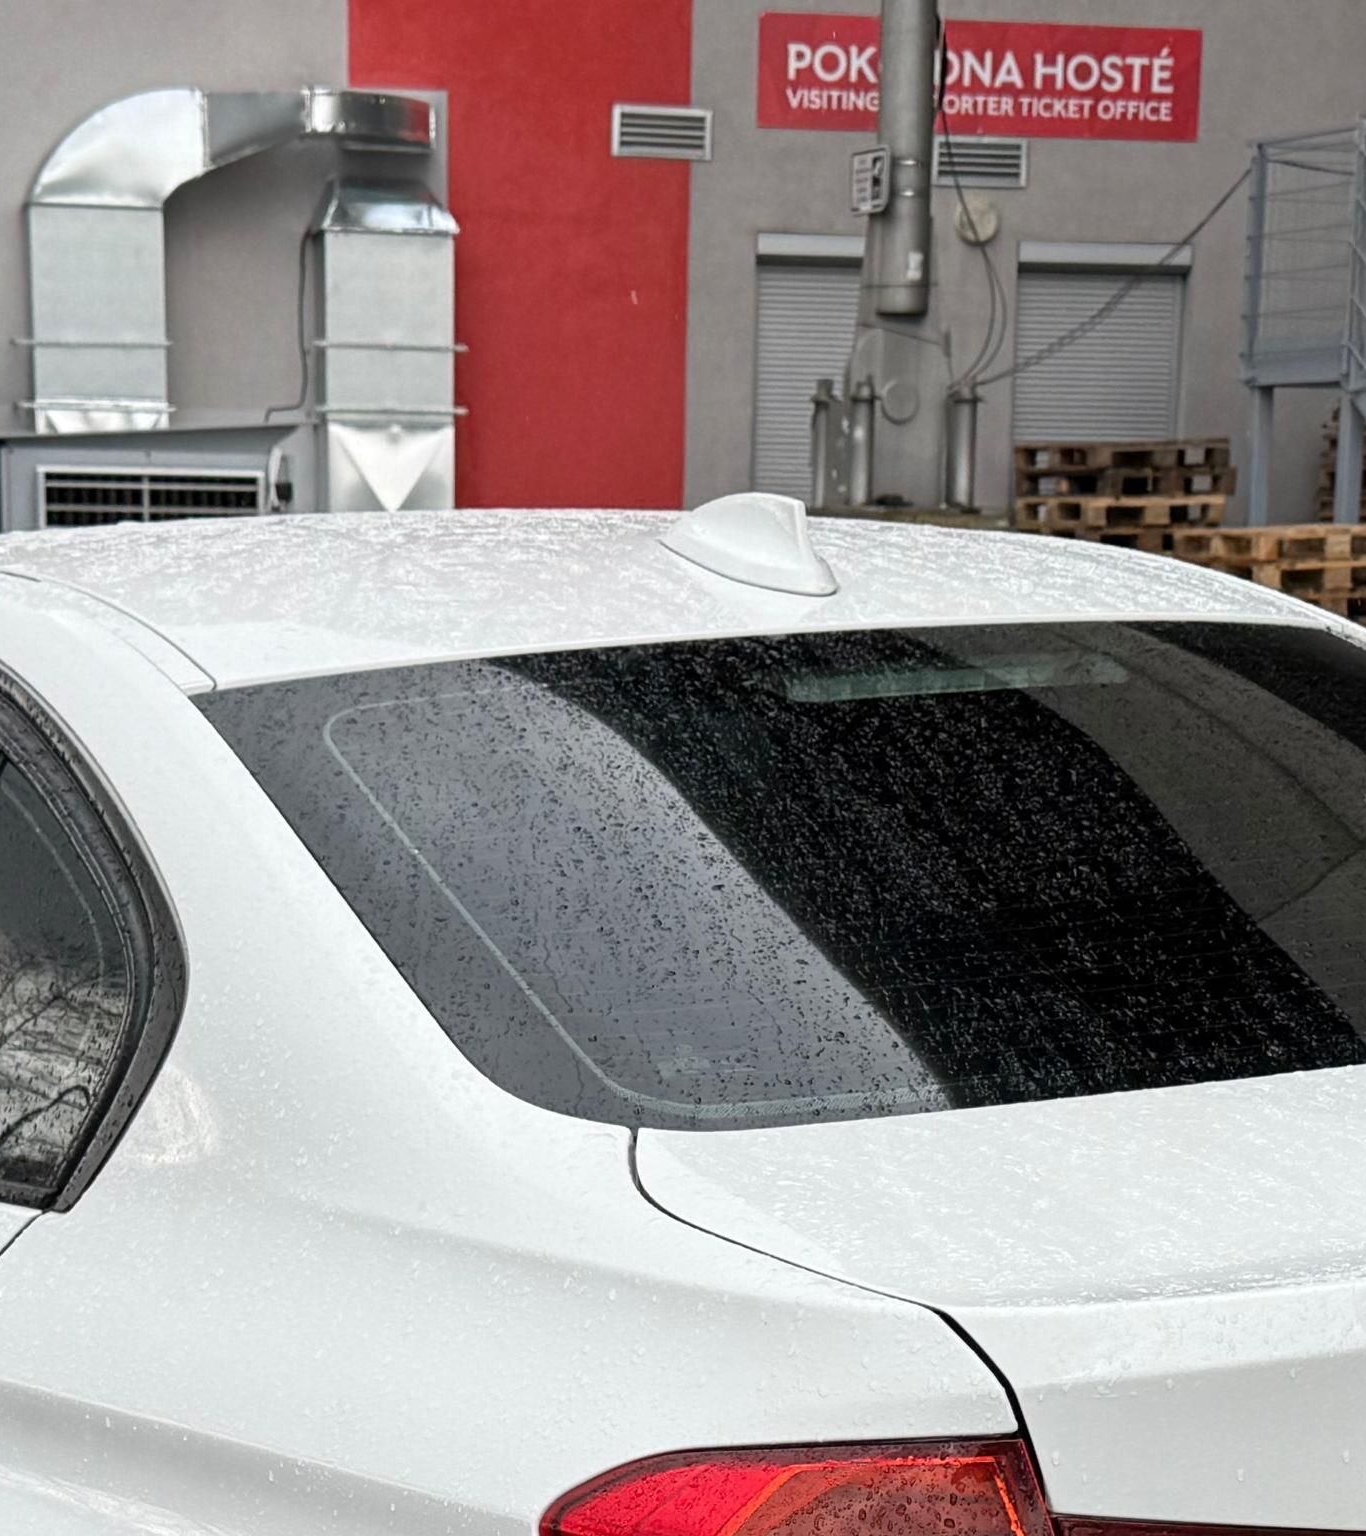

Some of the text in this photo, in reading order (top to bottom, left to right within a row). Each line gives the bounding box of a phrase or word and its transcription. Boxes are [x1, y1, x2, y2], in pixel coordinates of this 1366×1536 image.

[787, 43, 1175, 93] POKDNA HOSTÉ
[786, 87, 1173, 121] VISITING ORTER TICKET OFFICE
